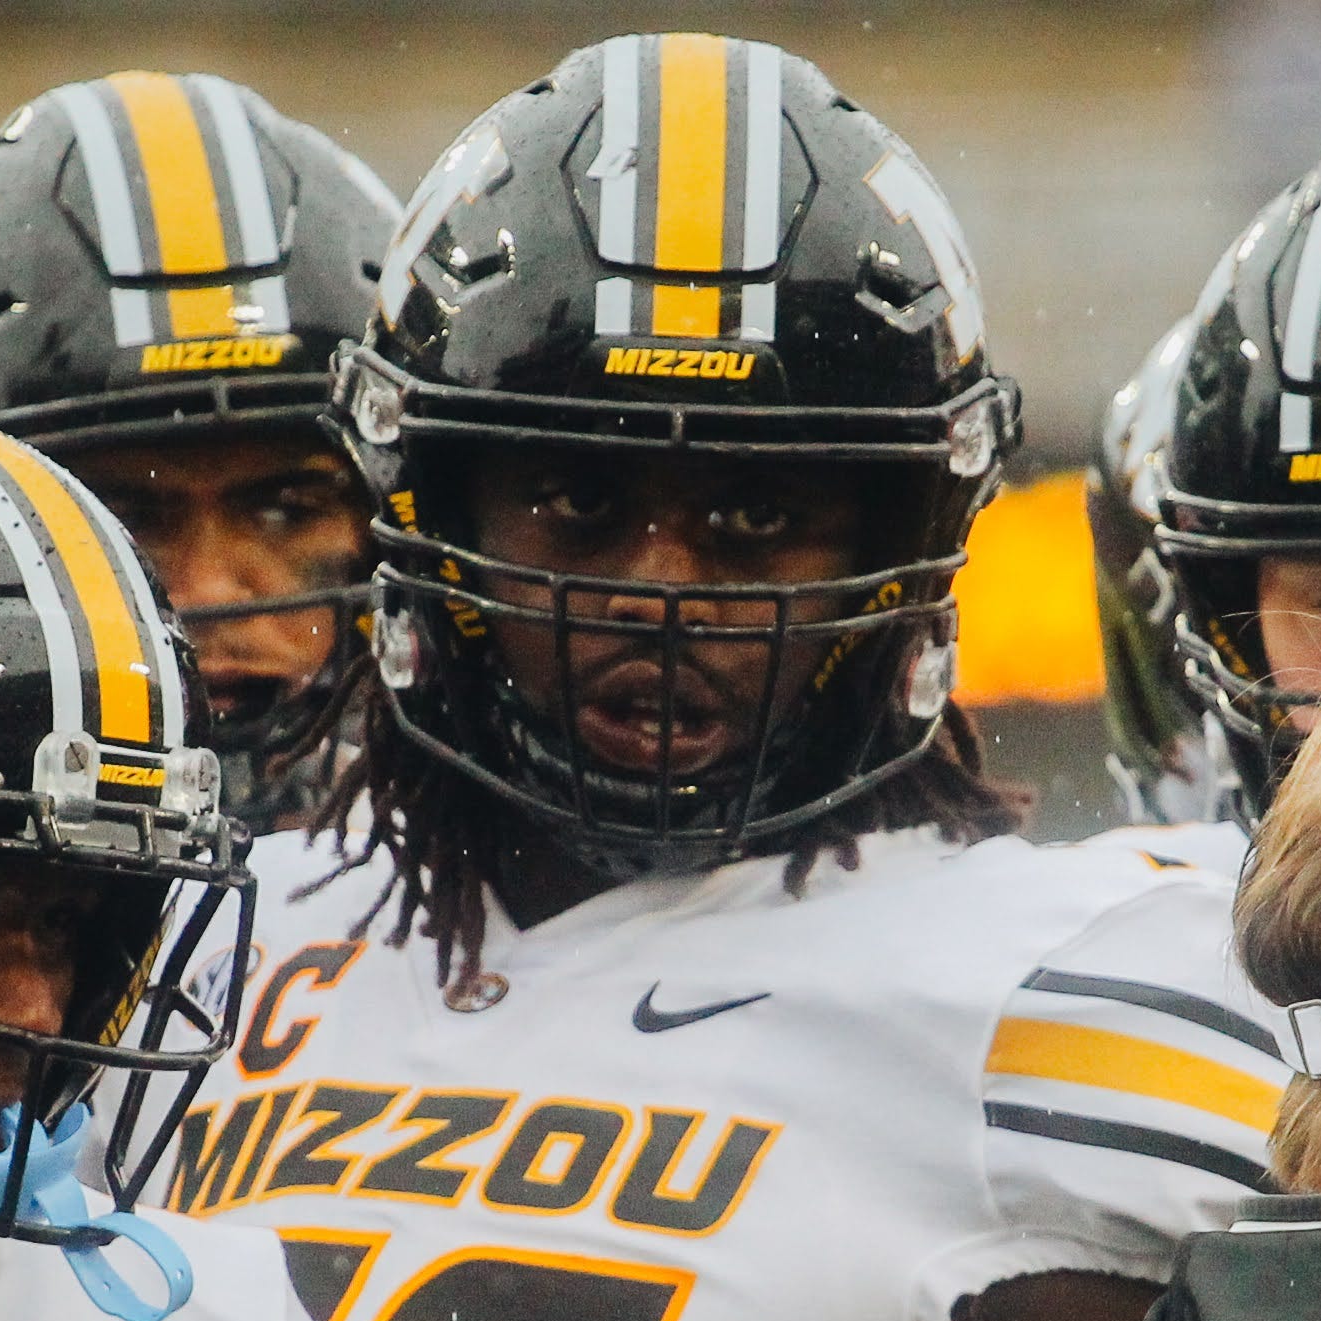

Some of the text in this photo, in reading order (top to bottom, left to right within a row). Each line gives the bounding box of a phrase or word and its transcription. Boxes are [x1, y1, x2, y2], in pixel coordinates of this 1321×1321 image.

[141, 335, 289, 373] MIZZOU
[604, 347, 757, 381] MIZZOU
[235, 939, 369, 1081] C
[164, 1077, 786, 1239] MIZZOU
